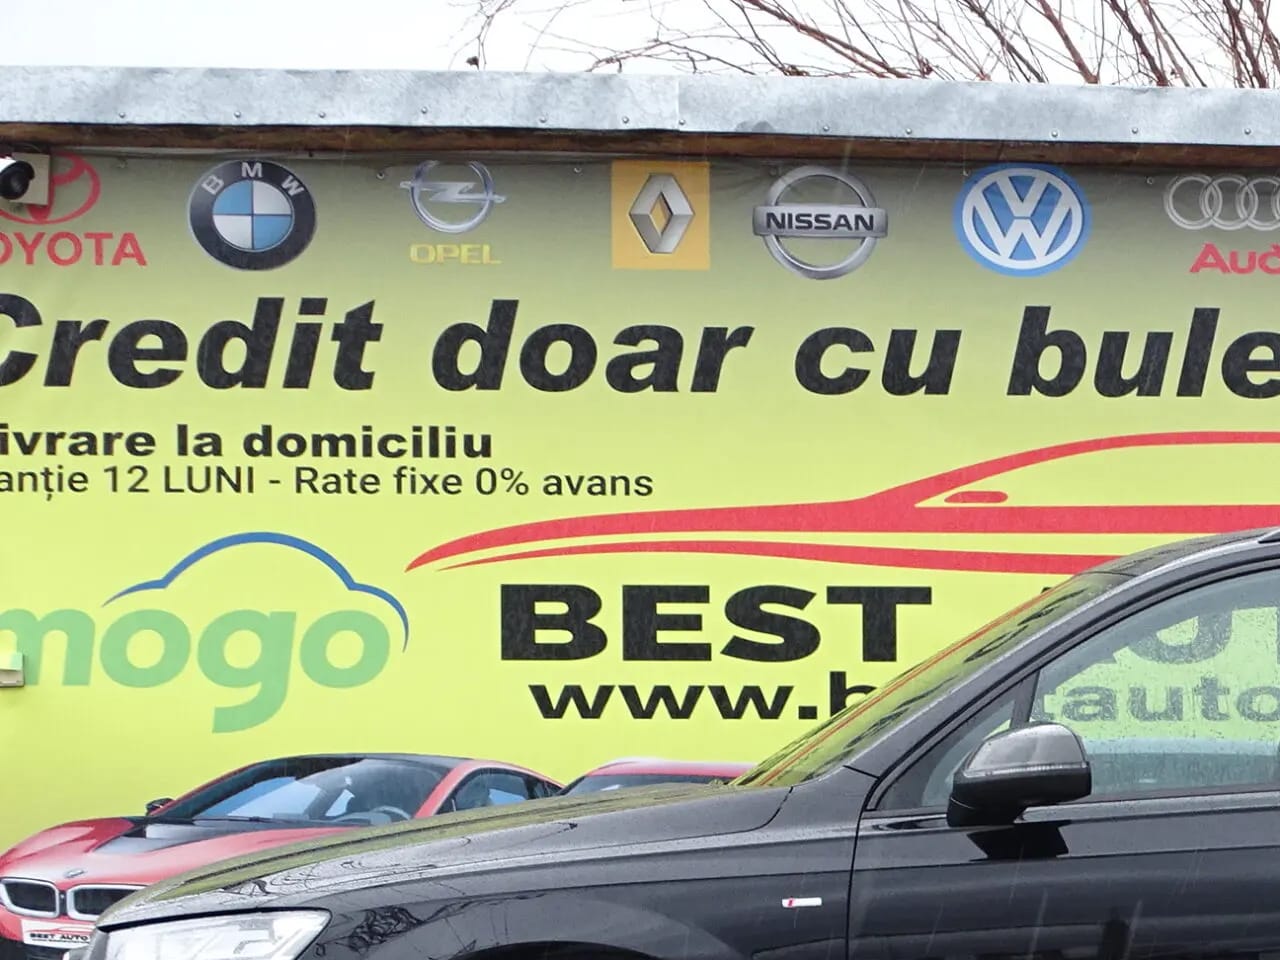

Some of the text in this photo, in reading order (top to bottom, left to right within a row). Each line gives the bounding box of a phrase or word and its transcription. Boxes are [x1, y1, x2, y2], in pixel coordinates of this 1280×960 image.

[202, 161, 305, 196] BMW
[765, 210, 875, 233] NISSAN
[409, 242, 502, 265] OPEL
[0, 293, 384, 390] Credit
[430, 299, 755, 393] doar
[794, 326, 962, 397] cu
[176, 424, 223, 457] la
[243, 425, 493, 459] domiciliu
[104, 465, 150, 493] 12
[163, 465, 255, 494] LUNI
[294, 466, 380, 496] Rate
[392, 466, 463, 496] fixe
[474, 467, 530, 496] 0%
[542, 473, 655, 498] avans
[501, 583, 933, 663] BEST
